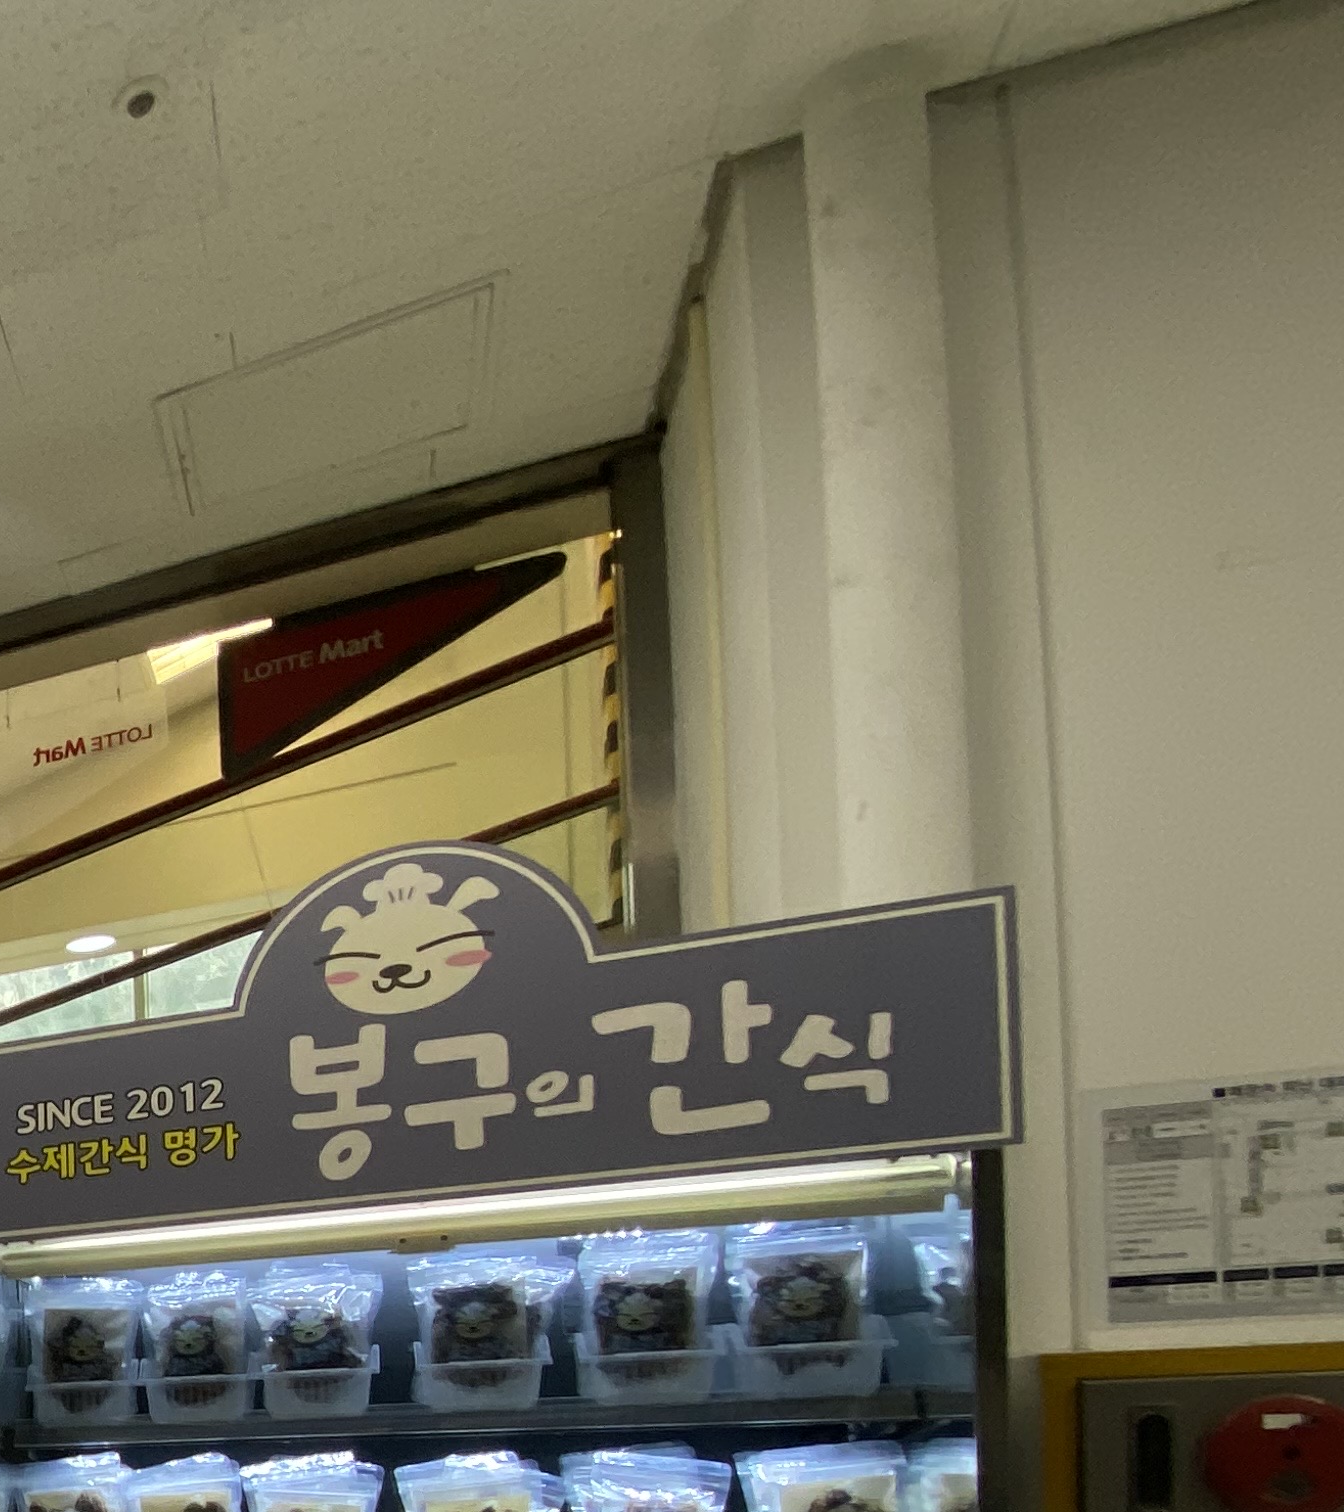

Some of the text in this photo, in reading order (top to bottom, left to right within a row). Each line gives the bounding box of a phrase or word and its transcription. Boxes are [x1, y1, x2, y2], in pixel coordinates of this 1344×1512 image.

[243, 629, 385, 684] LOTTE Mart
[15, 1078, 226, 1136] SINCE 2012
[287, 980, 893, 1182] 봉구의 간식
[6, 1122, 242, 1186] 수제간식 명가
